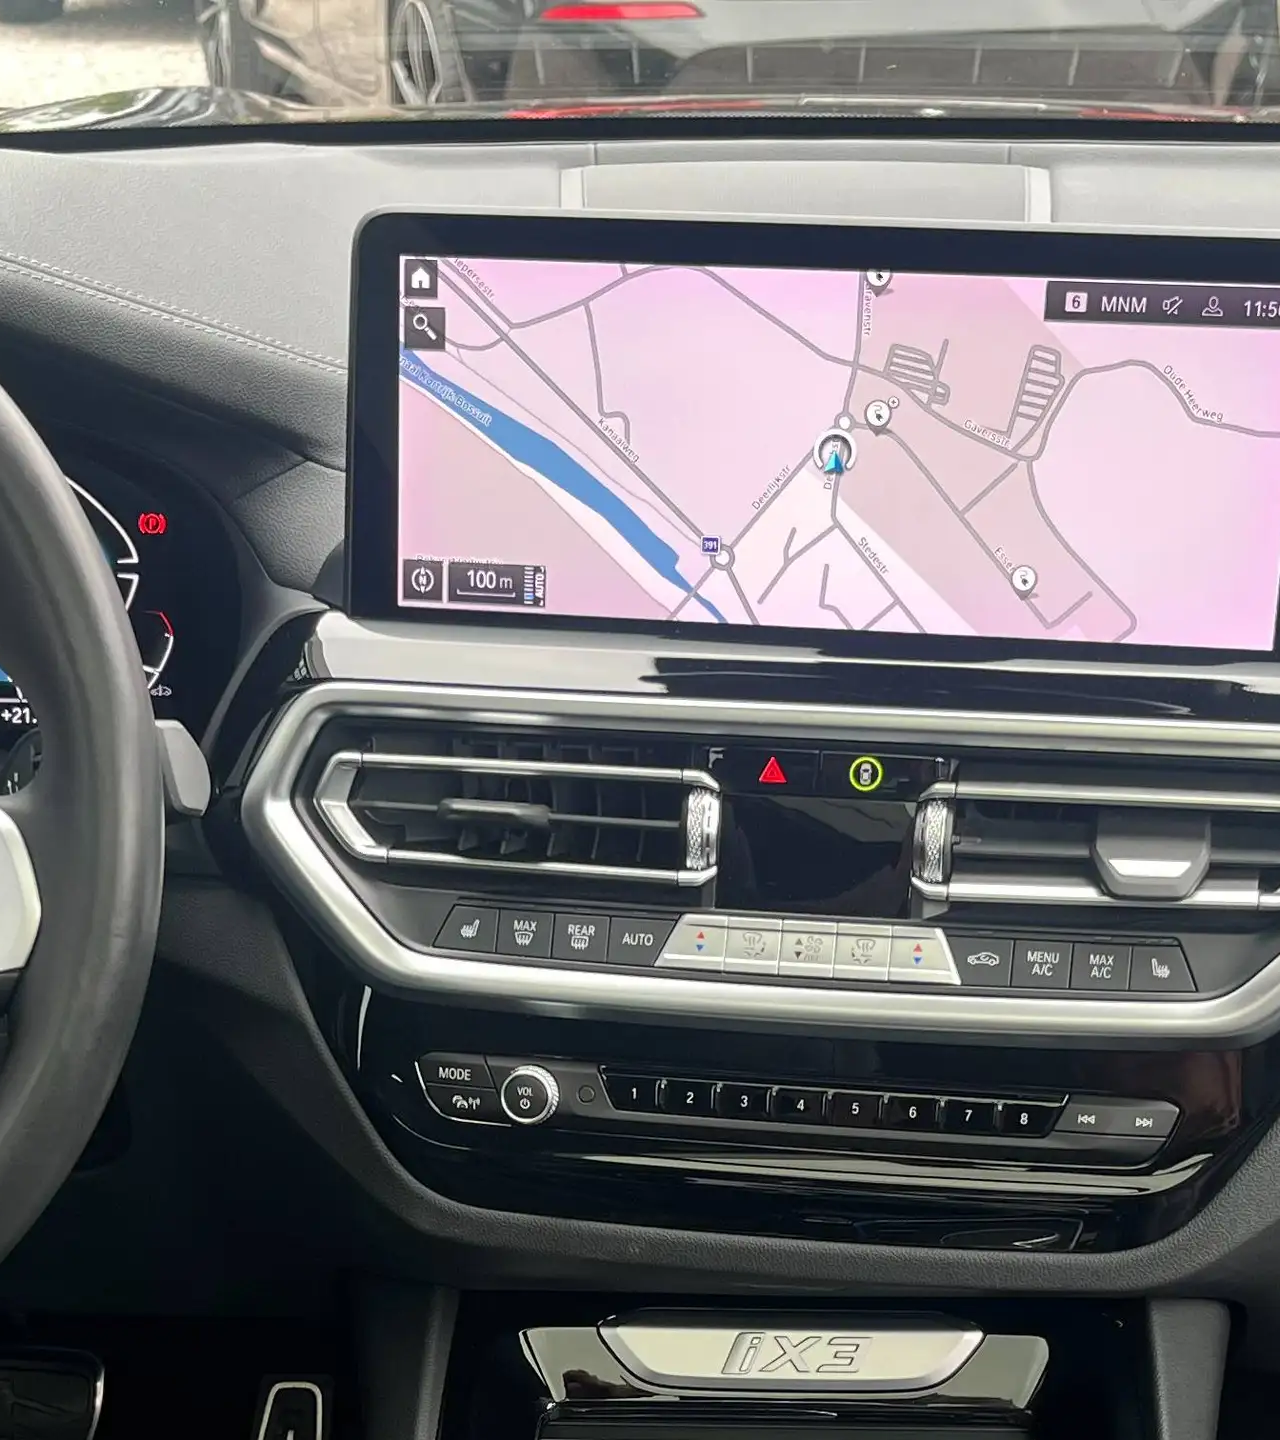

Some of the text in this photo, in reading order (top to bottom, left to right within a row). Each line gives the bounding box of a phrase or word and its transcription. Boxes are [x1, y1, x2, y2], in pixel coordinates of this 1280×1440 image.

[1071, 295, 1081, 310] 6
[1101, 295, 1147, 314] MNM
[1163, 365, 1224, 423] Oude Heerweg
[598, 418, 640, 464] Kanaalweg
[467, 569, 513, 590] 100 m
[535, 573, 545, 599] AUTO
[513, 919, 537, 932] MAX
[567, 924, 595, 936] REAR
[622, 933, 654, 947] AUTO
[1026, 951, 1060, 964] MENU
[1089, 954, 1114, 966] MAX
[1031, 964, 1053, 976] A/C
[1090, 966, 1112, 979] A/C
[438, 1066, 472, 1081] MODE
[516, 1086, 534, 1097] VOL
[631, 1087, 1029, 1125] 1 2 3 4 5 6 7 8
